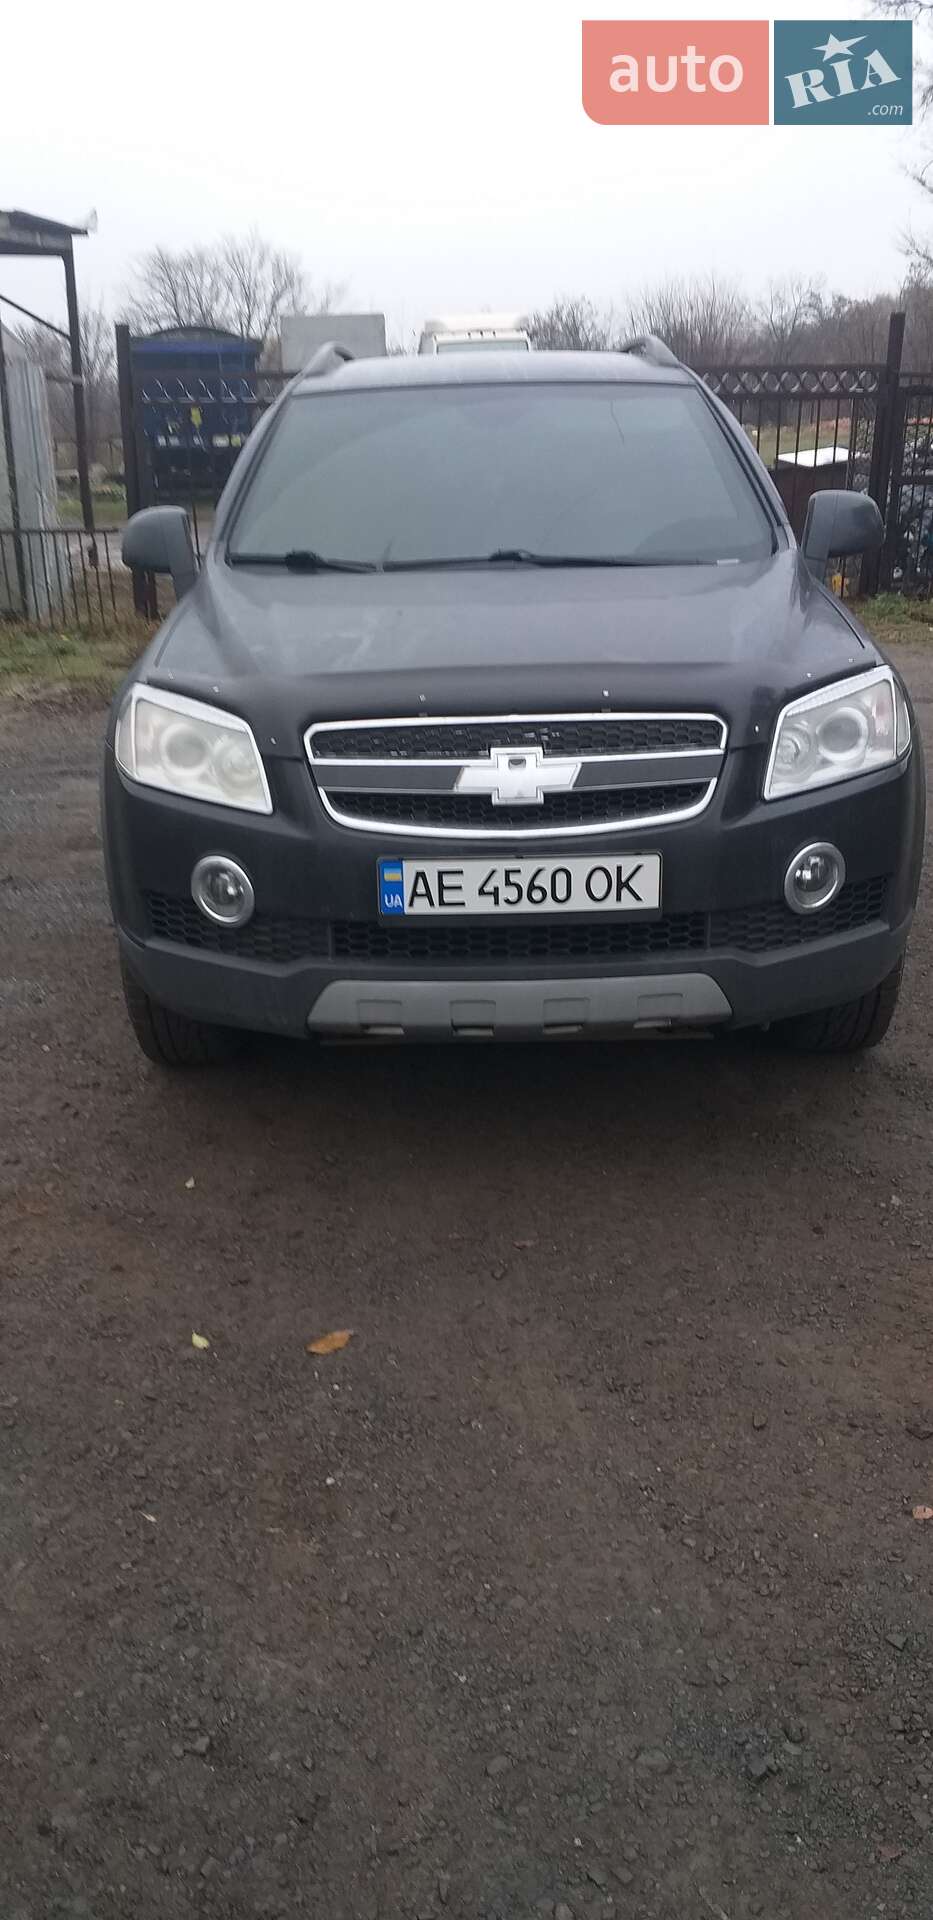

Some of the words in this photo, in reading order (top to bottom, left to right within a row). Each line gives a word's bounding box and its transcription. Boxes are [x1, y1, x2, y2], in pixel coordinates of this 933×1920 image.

[408, 869, 466, 908] AE
[478, 866, 572, 906] 4560
[585, 863, 644, 903] OK
[384, 894, 403, 909] UA
